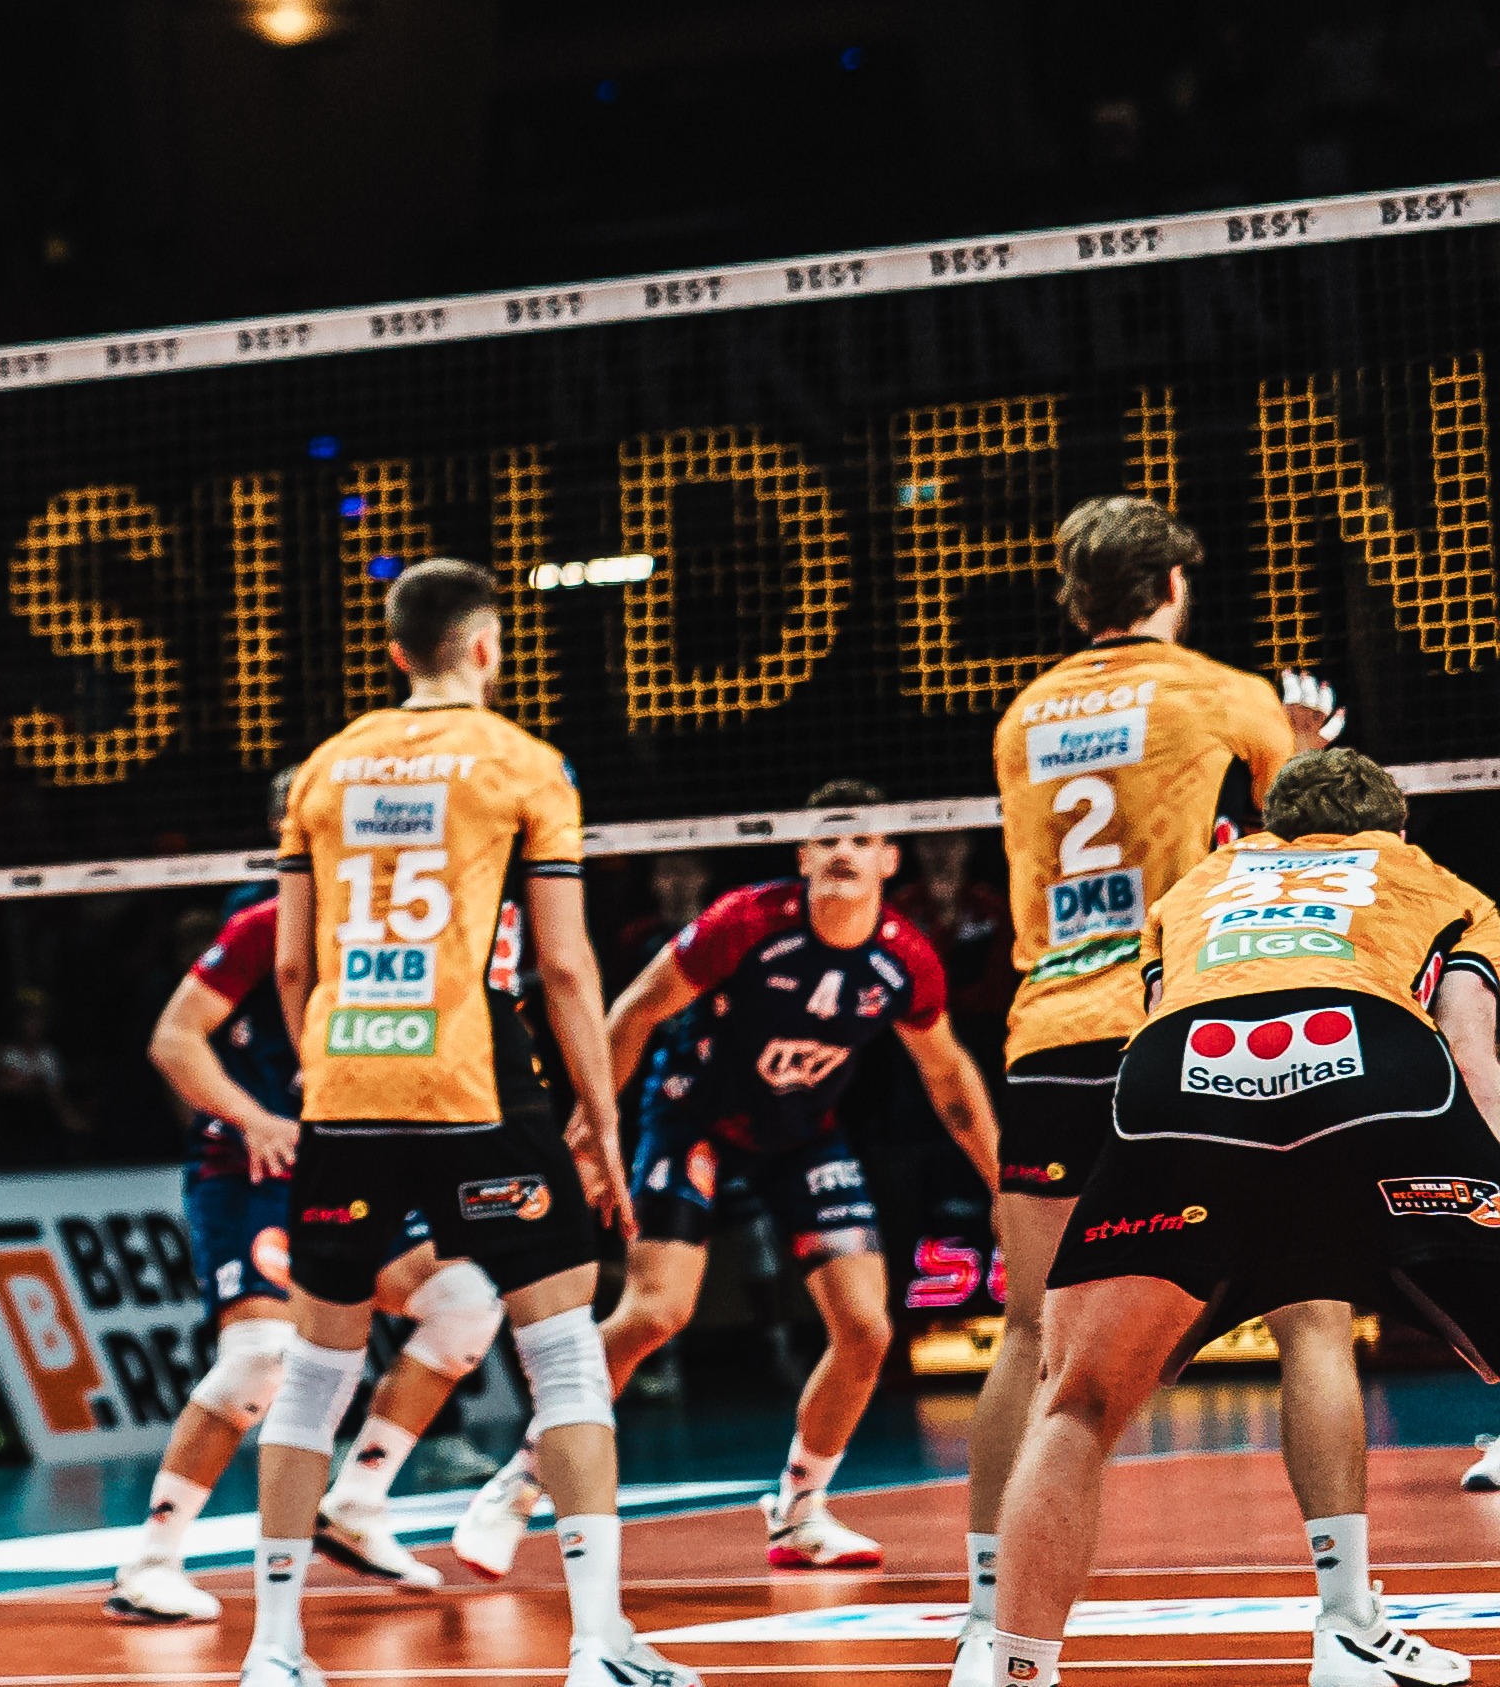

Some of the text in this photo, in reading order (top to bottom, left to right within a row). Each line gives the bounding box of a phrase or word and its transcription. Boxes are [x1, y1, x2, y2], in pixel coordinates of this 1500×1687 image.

[505, 290, 583, 323] BEST
[644, 275, 724, 308] BEST
[785, 259, 866, 292] BEST
[928, 242, 1011, 276] BEST
[1076, 225, 1162, 259] BEST
[1226, 208, 1311, 242] BEST
[1379, 190, 1470, 225] BEST
[1052, 775, 1123, 877] 2
[334, 850, 454, 945] 15
[1055, 874, 1135, 921] DKB
[1201, 864, 1379, 921] 33
[1221, 904, 1337, 925] DKB
[346, 949, 426, 983] DKB
[1206, 932, 1345, 963] LIGO
[329, 1012, 431, 1051] LIGO
[1188, 1053, 1358, 1099] Securitas
